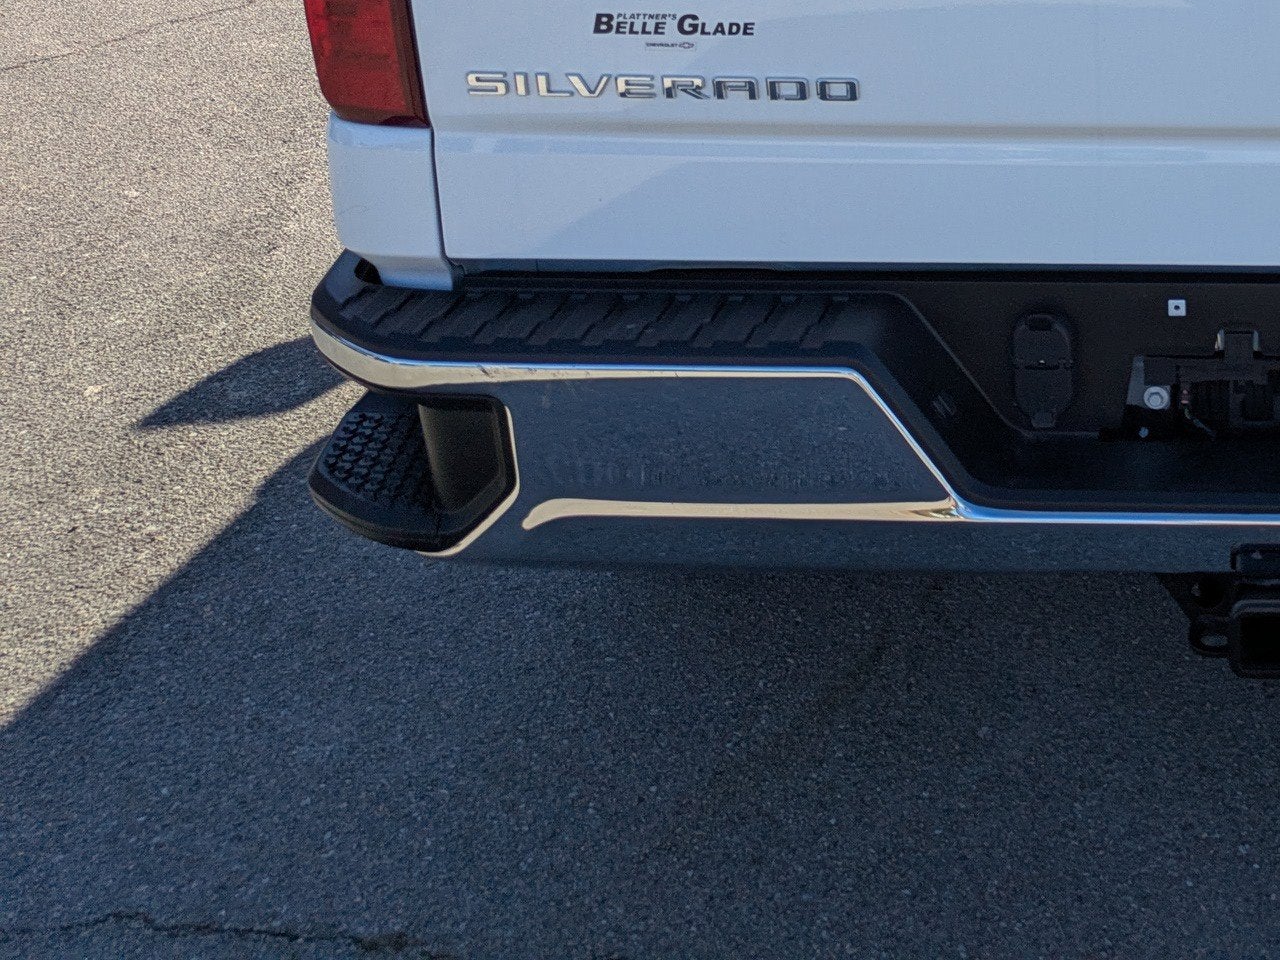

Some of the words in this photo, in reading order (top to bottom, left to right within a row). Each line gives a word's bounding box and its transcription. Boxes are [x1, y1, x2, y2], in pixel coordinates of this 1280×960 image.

[593, 13, 667, 35] BELLE
[677, 13, 756, 36] GLADE
[616, 13, 677, 21] PLATTNER'S
[465, 70, 861, 102] SILVERADO
